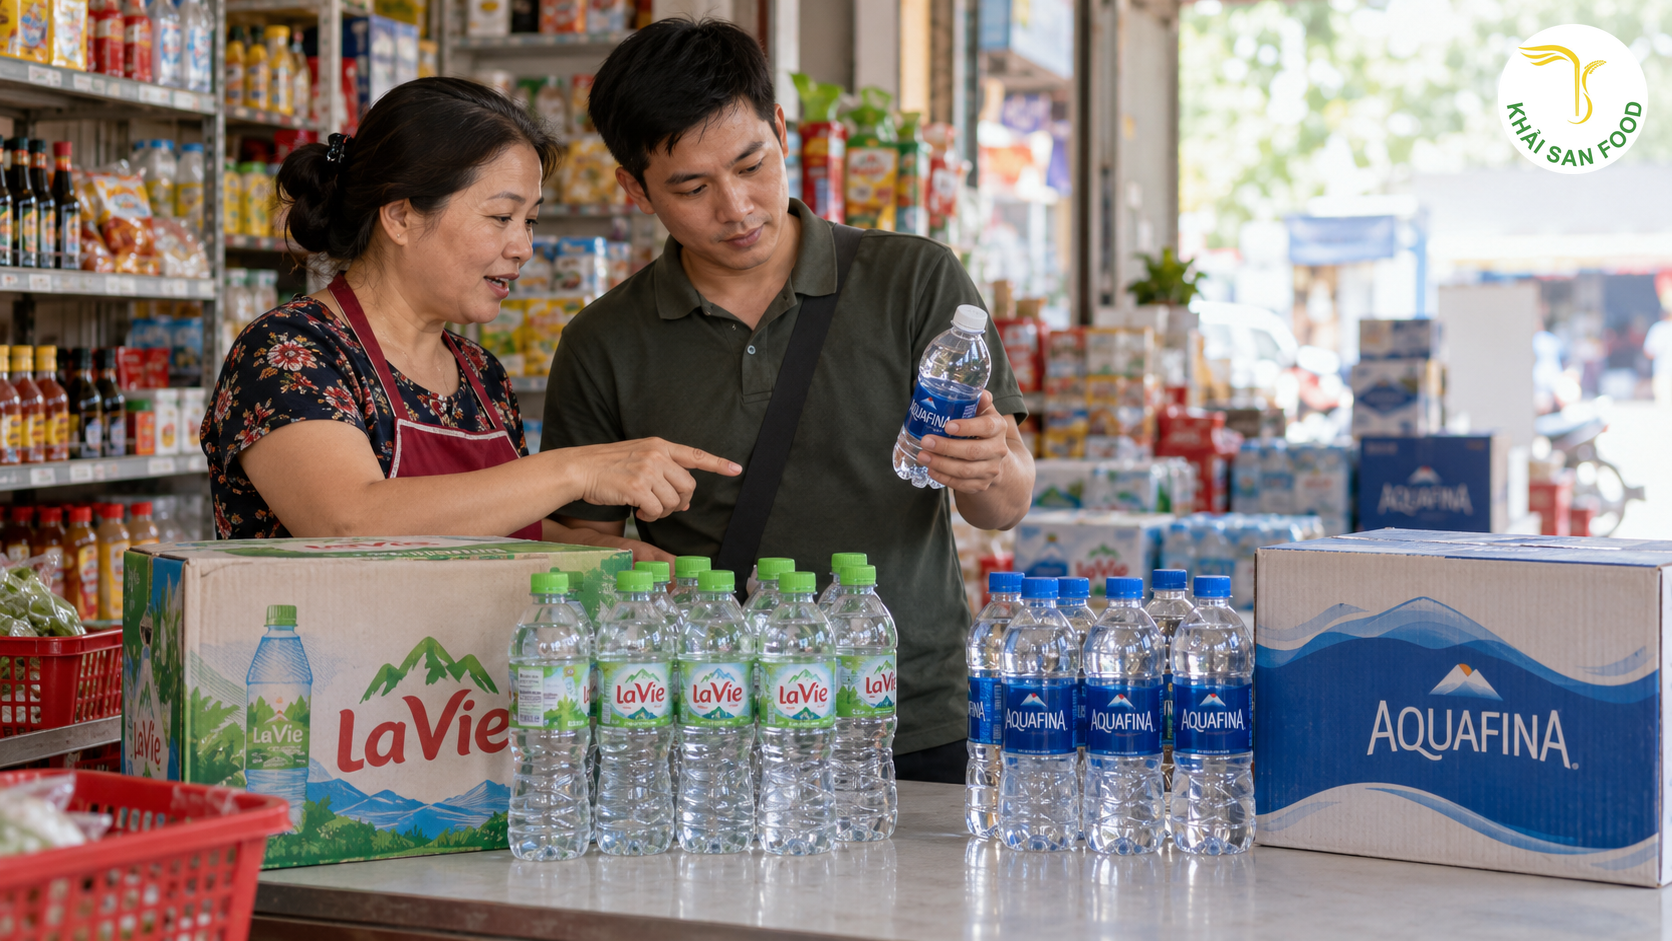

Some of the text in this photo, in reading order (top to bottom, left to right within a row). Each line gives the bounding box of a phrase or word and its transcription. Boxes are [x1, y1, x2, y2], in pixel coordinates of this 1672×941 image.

[616, 681, 665, 704] LaVie
[692, 680, 743, 704] LaVie
[779, 681, 828, 705] LaVie
[336, 688, 509, 773] LaVie
[1005, 708, 1067, 732] AQUAFINA
[1090, 708, 1154, 734] AQUAFINA
[1181, 708, 1246, 734] AQUAFINA
[133, 719, 161, 765] LaVie
[253, 724, 303, 744] LaVie
[1366, 699, 1572, 770] AQUAFINA
